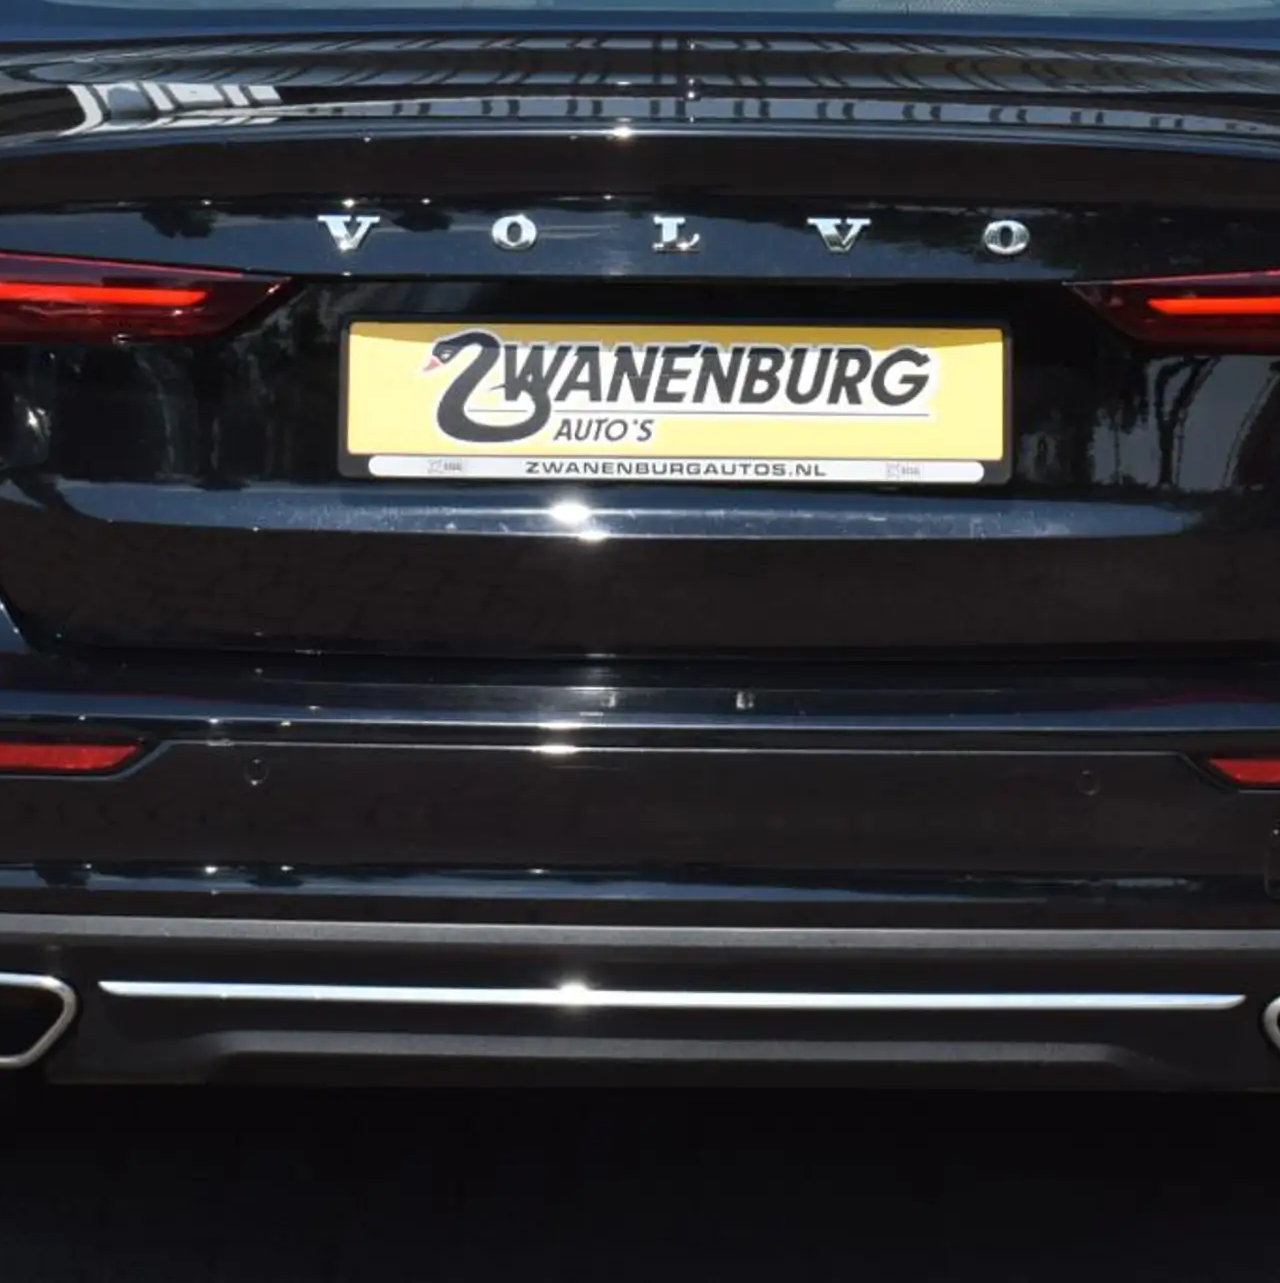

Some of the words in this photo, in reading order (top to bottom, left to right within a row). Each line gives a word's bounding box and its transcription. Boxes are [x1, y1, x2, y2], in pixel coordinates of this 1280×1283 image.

[317, 214, 1031, 255] VOLVO
[553, 418, 654, 442] AUTO'S
[525, 459, 827, 478] ZWANENBURGAUTOS.NL
